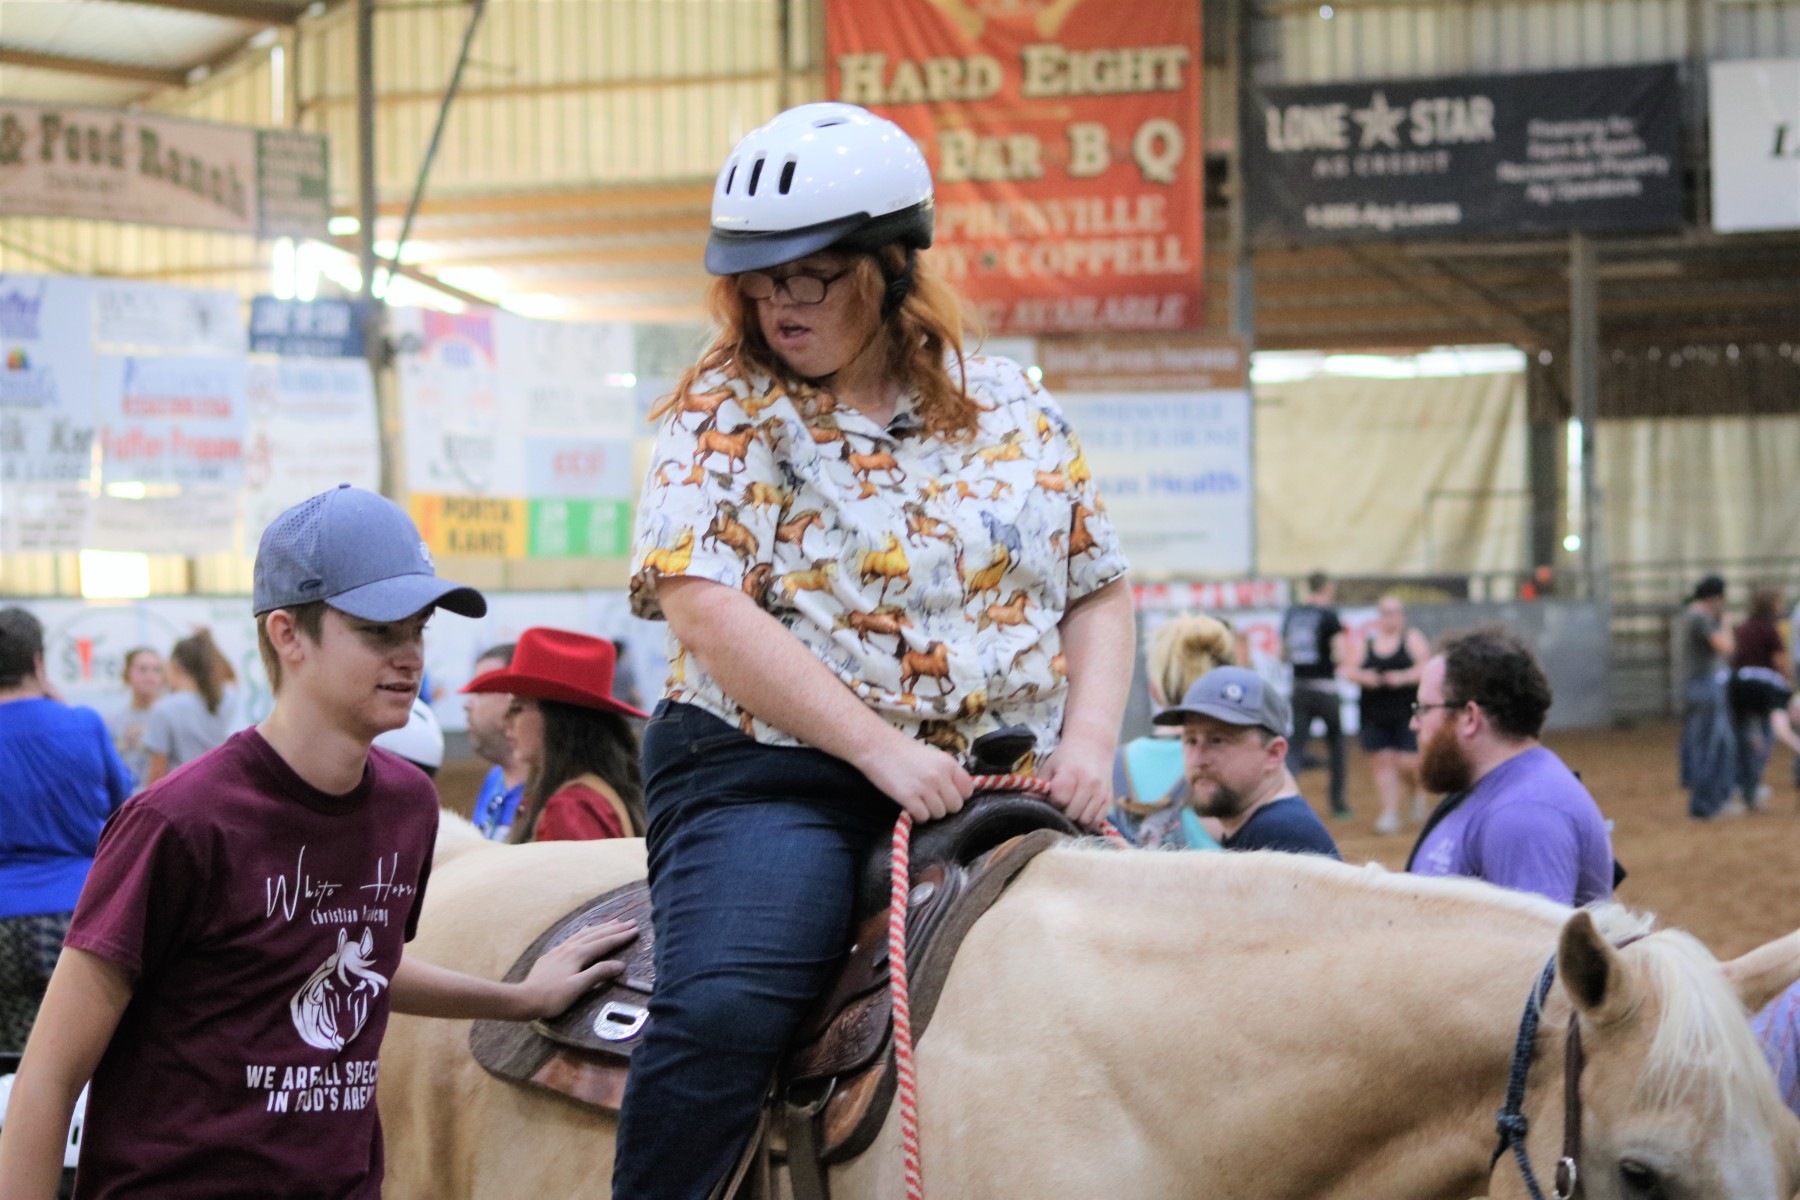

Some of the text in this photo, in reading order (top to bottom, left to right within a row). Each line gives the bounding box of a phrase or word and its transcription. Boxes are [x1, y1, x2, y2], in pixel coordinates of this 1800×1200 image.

[1265, 95, 1496, 152] LONE STAR
[266, 845, 342, 921] White
[311, 908, 358, 925] Christian
[246, 1065, 276, 1089] WE
[266, 1090, 289, 1113] IN
